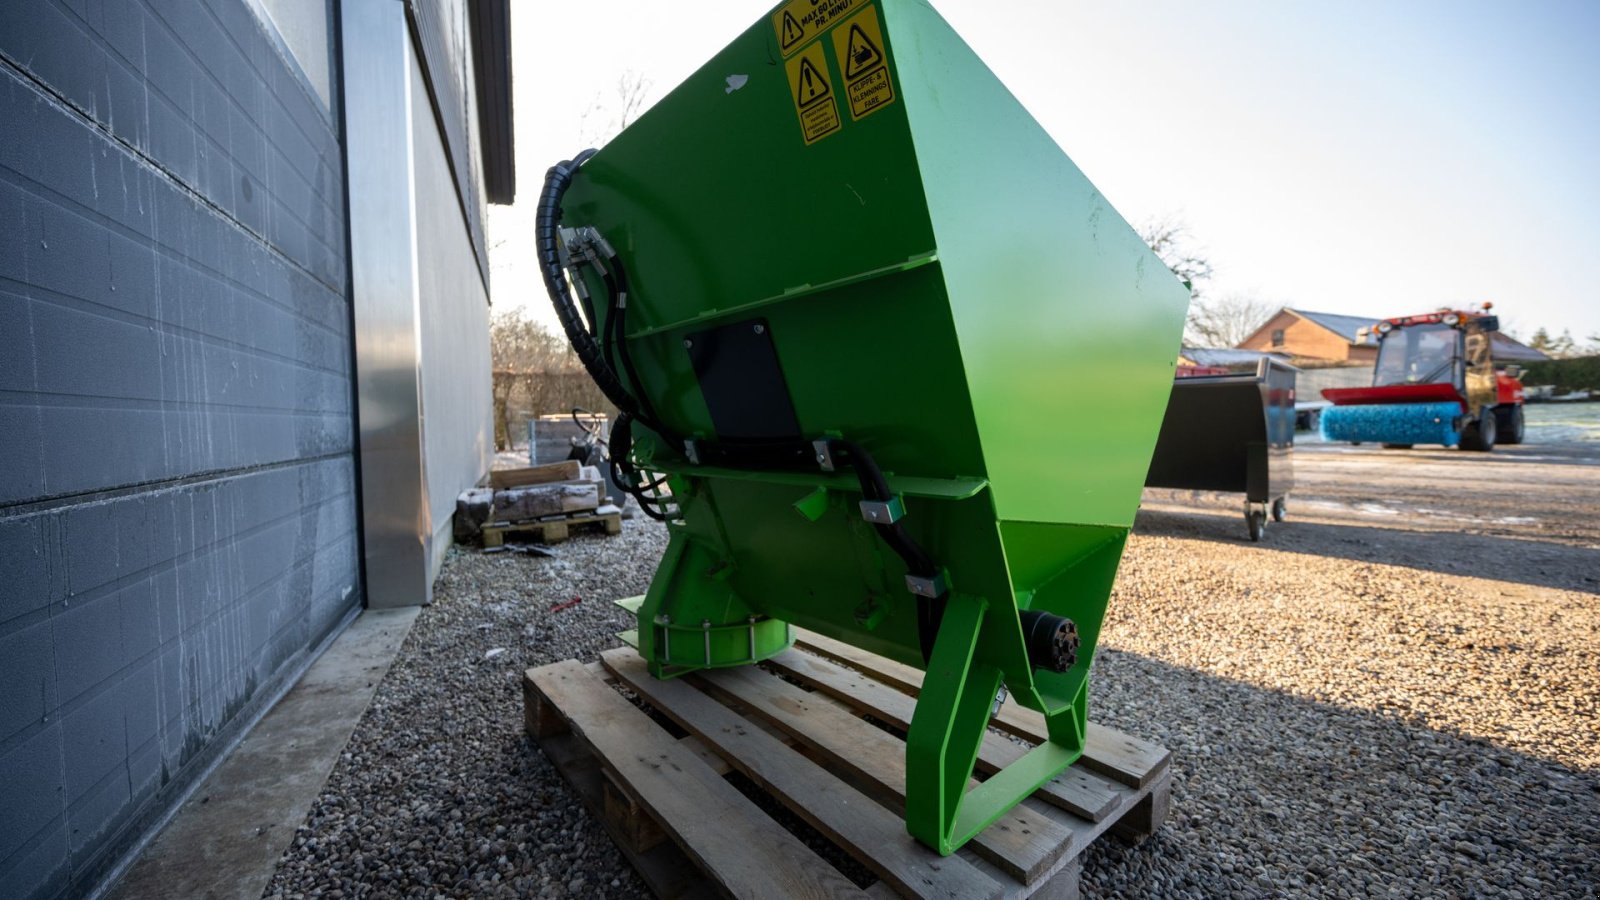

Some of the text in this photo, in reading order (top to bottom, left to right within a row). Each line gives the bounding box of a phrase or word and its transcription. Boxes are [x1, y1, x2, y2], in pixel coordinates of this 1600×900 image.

[801, 9, 818, 27] MAX
[815, 15, 828, 28] PR.
[864, 95, 879, 108] FARE
